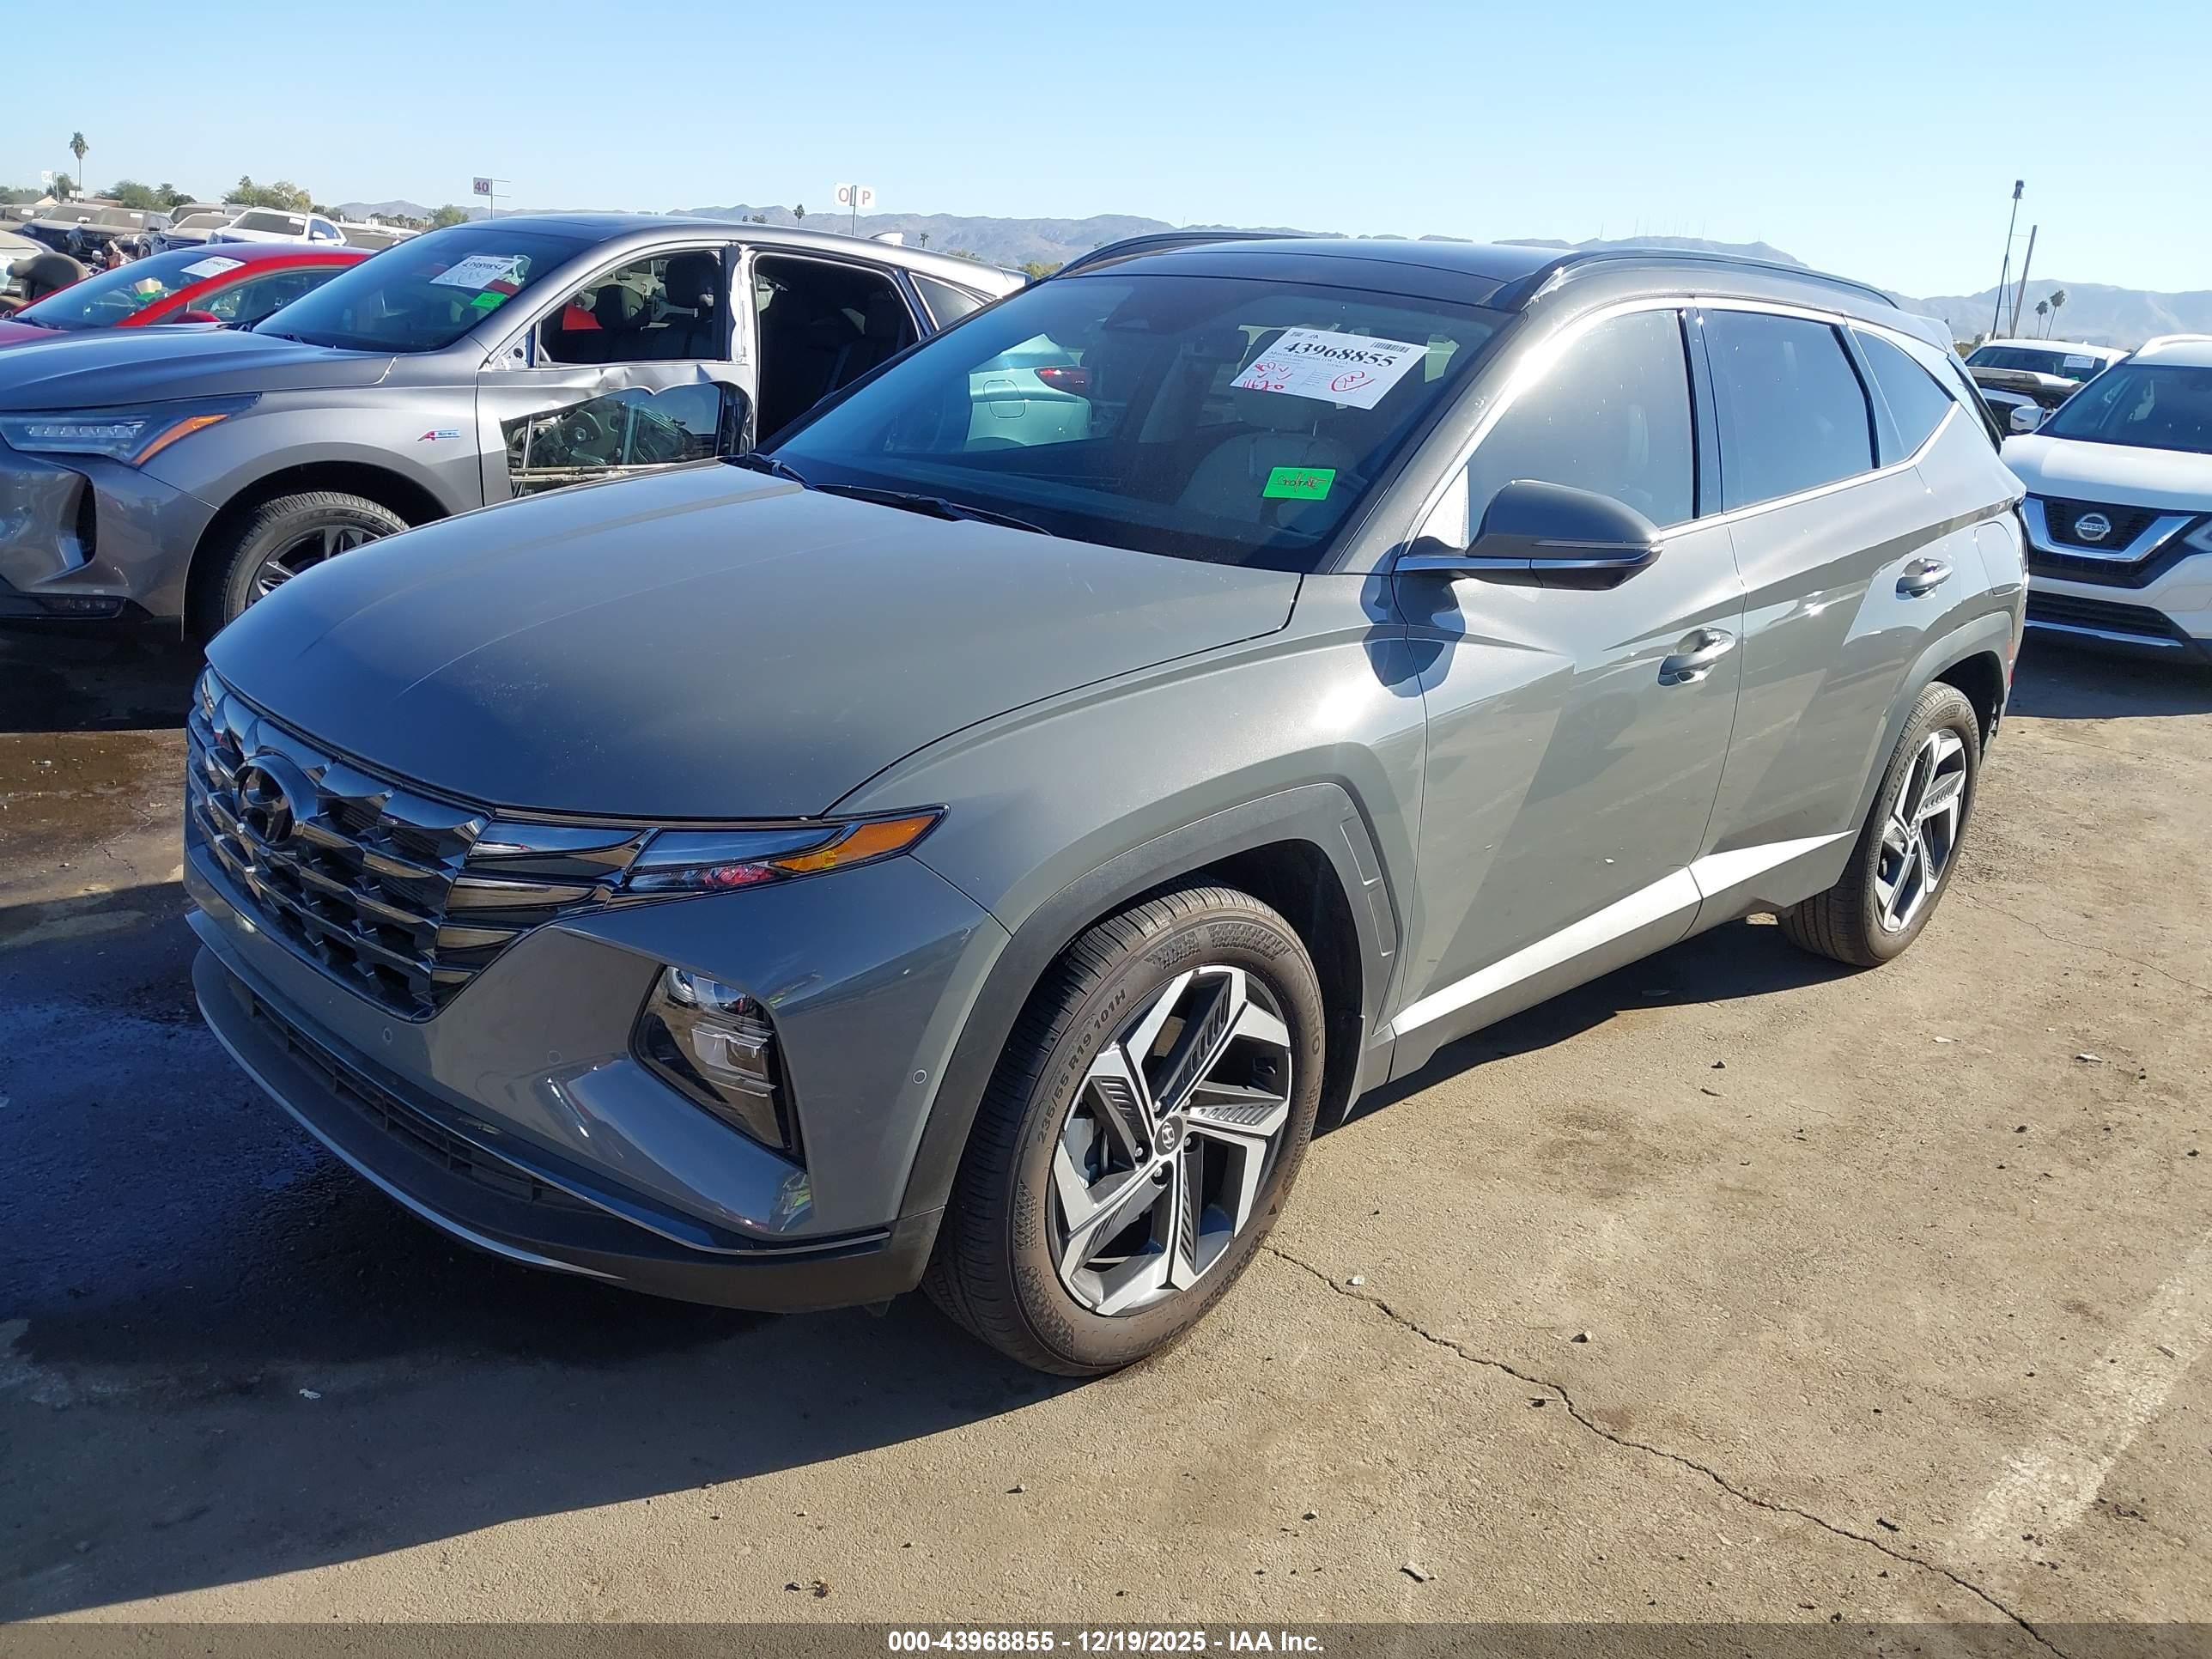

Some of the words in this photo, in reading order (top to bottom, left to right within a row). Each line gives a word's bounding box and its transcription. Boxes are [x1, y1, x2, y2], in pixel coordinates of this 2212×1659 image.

[474, 181, 489, 192] 40
[838, 187, 849, 203] O
[862, 190, 872, 205] P
[1284, 342, 1399, 368] 43968855
[1037, 1073, 1070, 1145] 235/55
[1067, 1033, 1093, 1070] R19
[1093, 988, 1127, 1030] 101H
